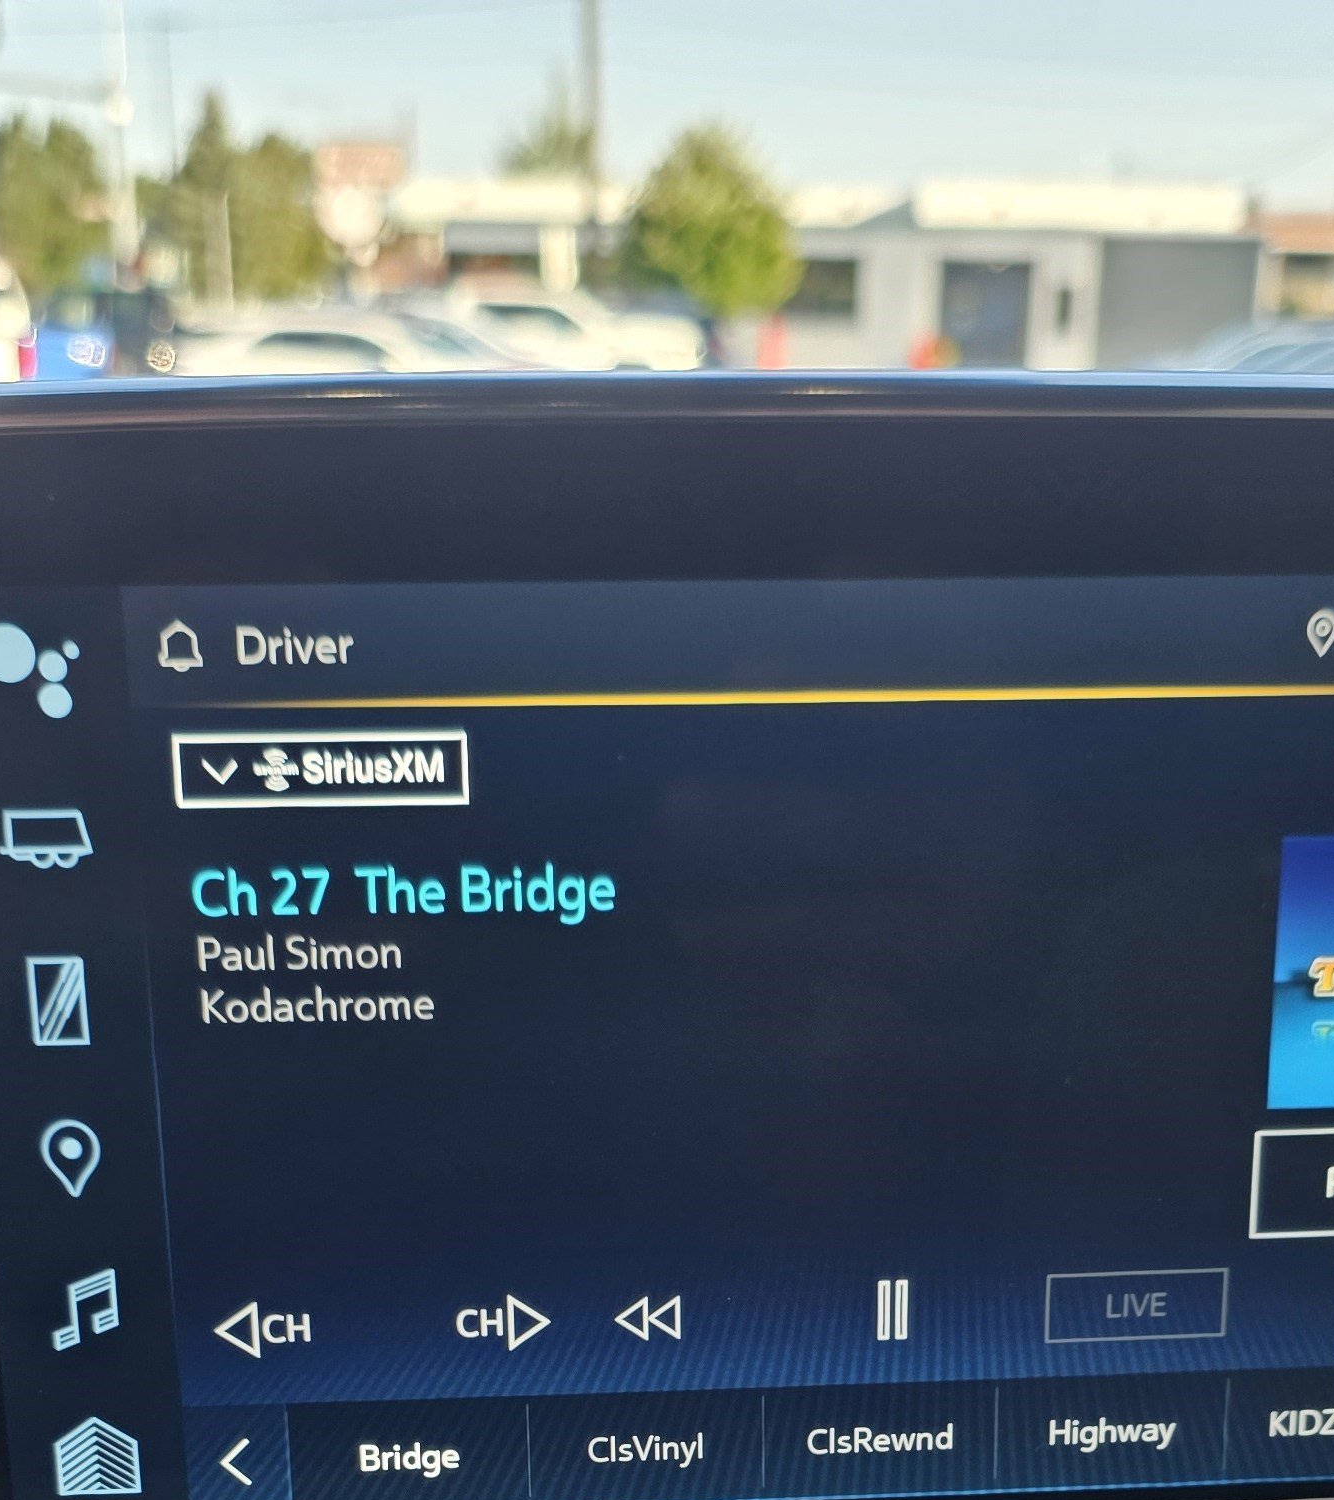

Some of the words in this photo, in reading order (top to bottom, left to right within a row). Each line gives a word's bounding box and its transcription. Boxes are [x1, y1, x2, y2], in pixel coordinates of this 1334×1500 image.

[235, 624, 355, 666] Driver
[302, 747, 445, 785] SiriusXM
[191, 866, 258, 918] Ch
[271, 867, 330, 916] 27
[354, 864, 446, 915] The
[460, 861, 617, 926] Bridge
[197, 933, 276, 972] Paul
[285, 935, 403, 971] Simon
[200, 985, 435, 1025] Kodachrome
[455, 1307, 504, 1338] CH
[1105, 1291, 1168, 1319] LIVE
[261, 1313, 313, 1344] CH
[587, 1431, 704, 1469] ClsVinyl
[806, 1422, 954, 1456] ClsRewnd
[1048, 1416, 1177, 1453] Highway
[358, 1441, 461, 1479] Bridge
